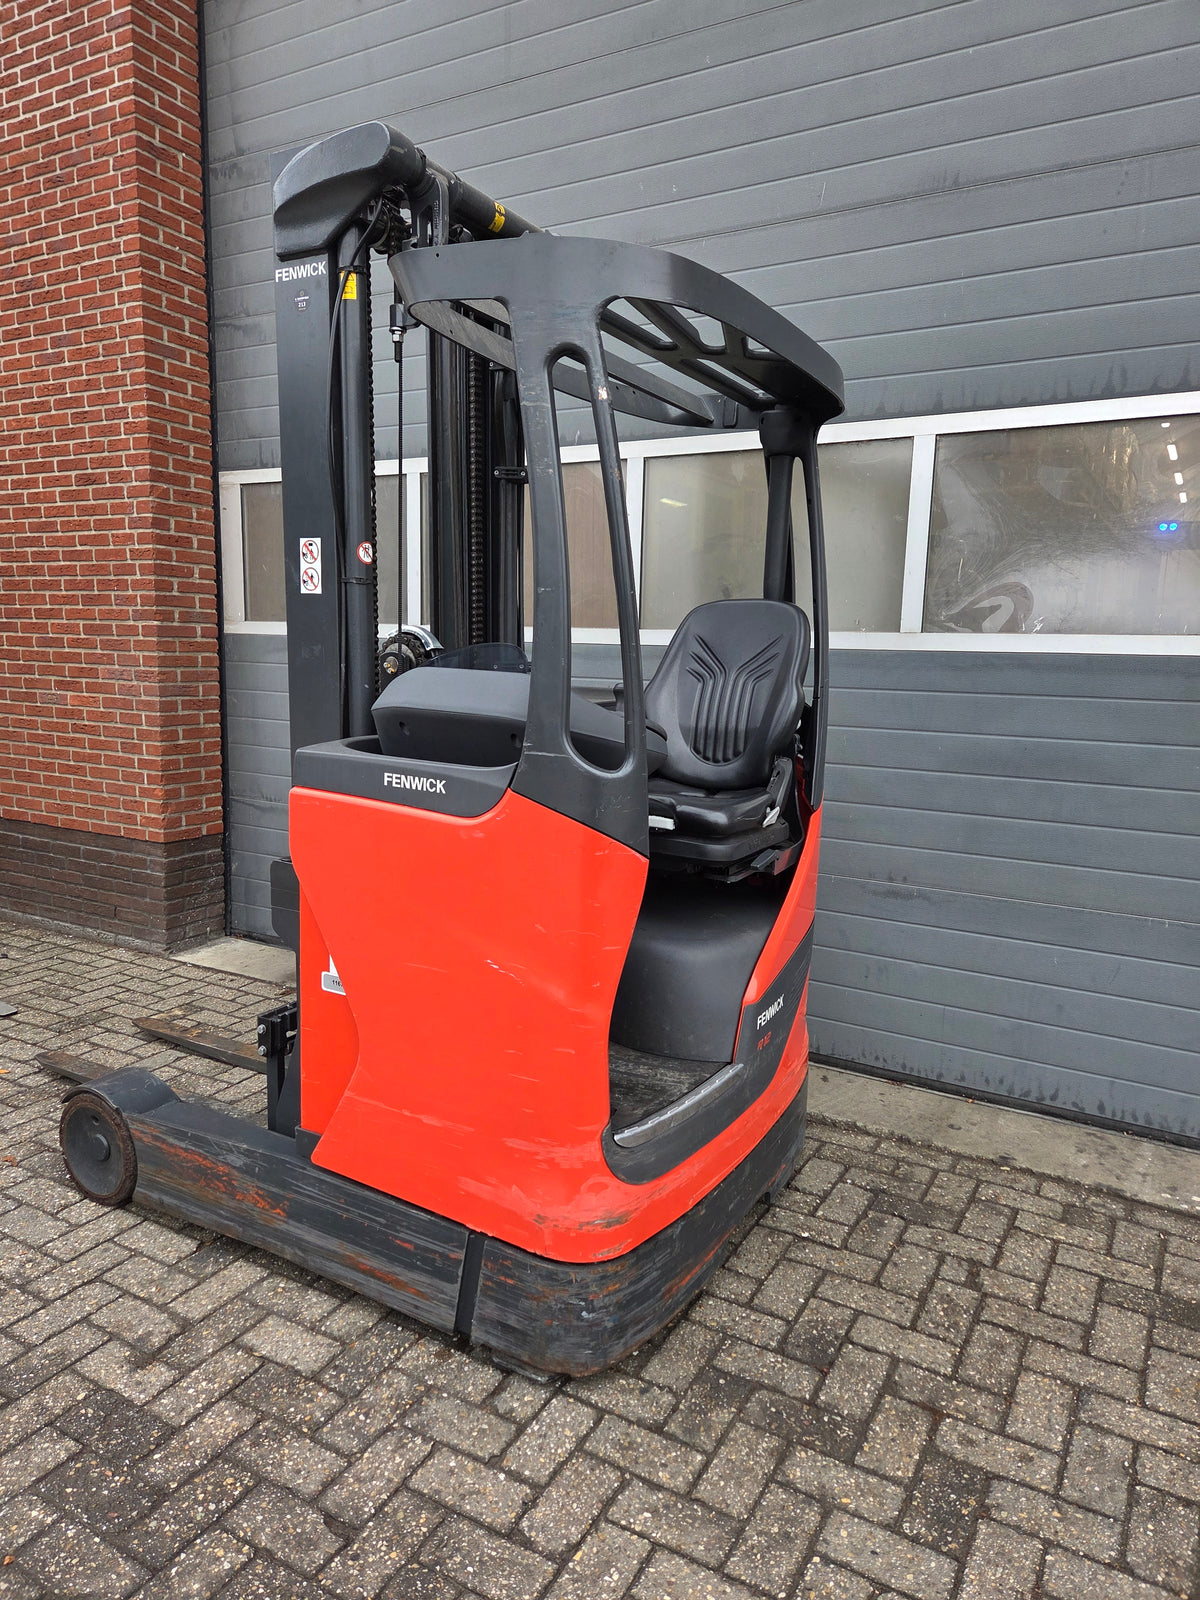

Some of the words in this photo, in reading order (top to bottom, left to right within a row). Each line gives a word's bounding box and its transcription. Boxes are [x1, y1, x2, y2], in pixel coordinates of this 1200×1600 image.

[275, 260, 327, 283] FENWICK
[383, 772, 447, 794] FENWICK
[756, 993, 785, 1031] FENWICK
